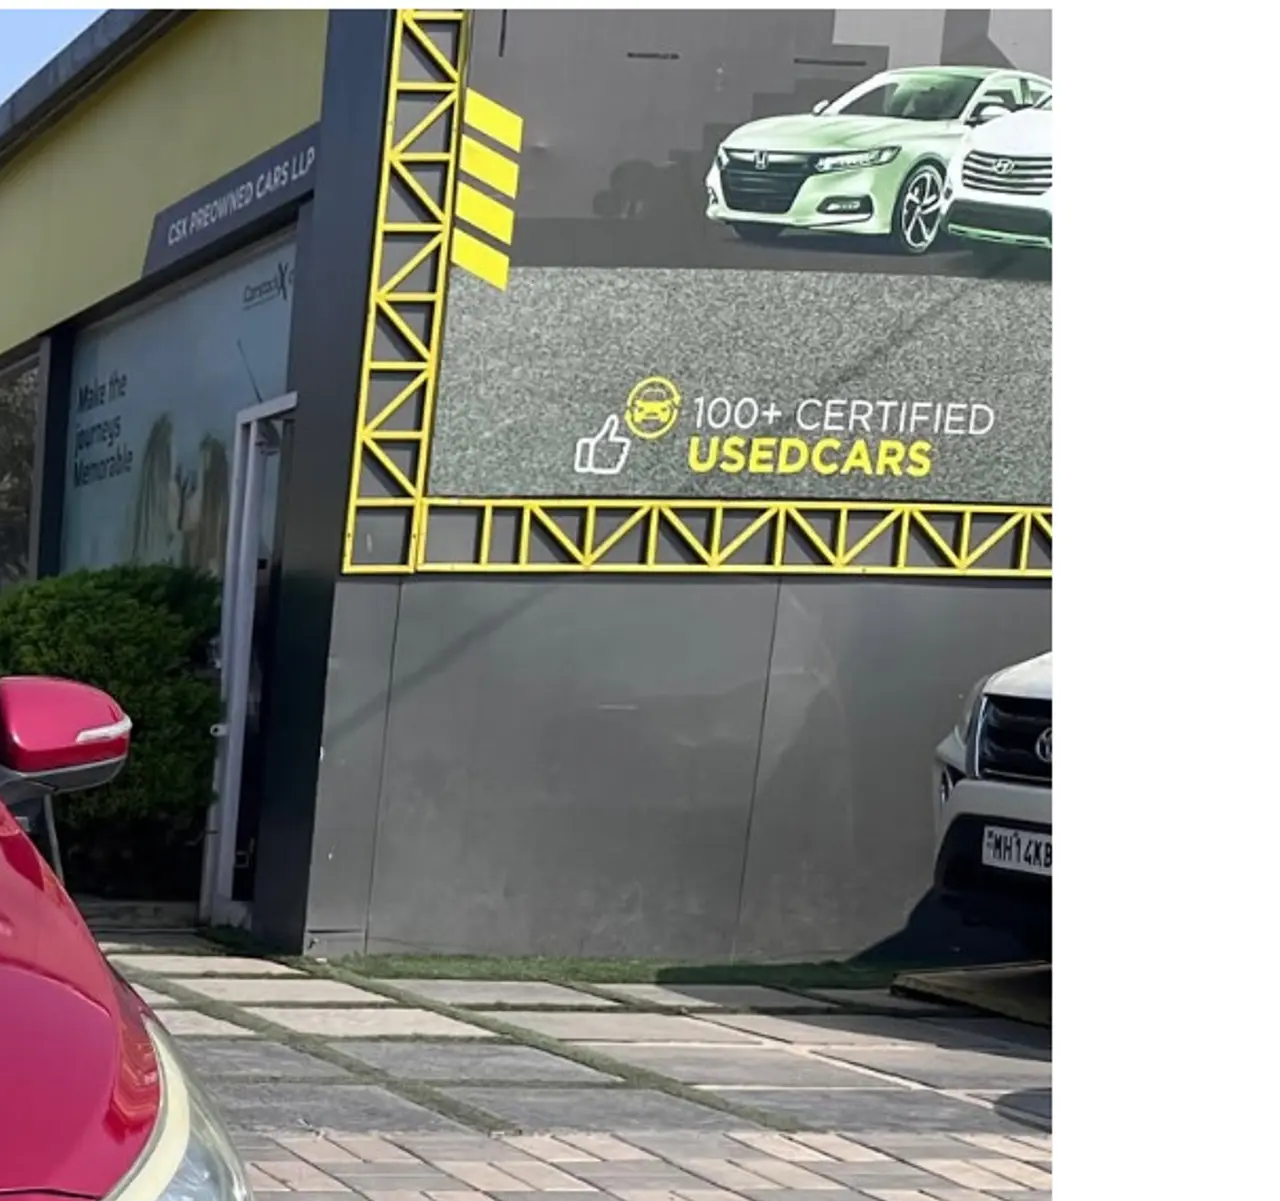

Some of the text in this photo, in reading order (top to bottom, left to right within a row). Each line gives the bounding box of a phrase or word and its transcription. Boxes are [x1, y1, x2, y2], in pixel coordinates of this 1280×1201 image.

[189, 181, 254, 234] PREOWNED
[255, 161, 290, 199] CARS
[291, 145, 316, 181] LLP
[78, 369, 128, 414] Make the
[692, 396, 996, 435] 100+ CERTIFIED
[687, 435, 933, 477] USEDCARS
